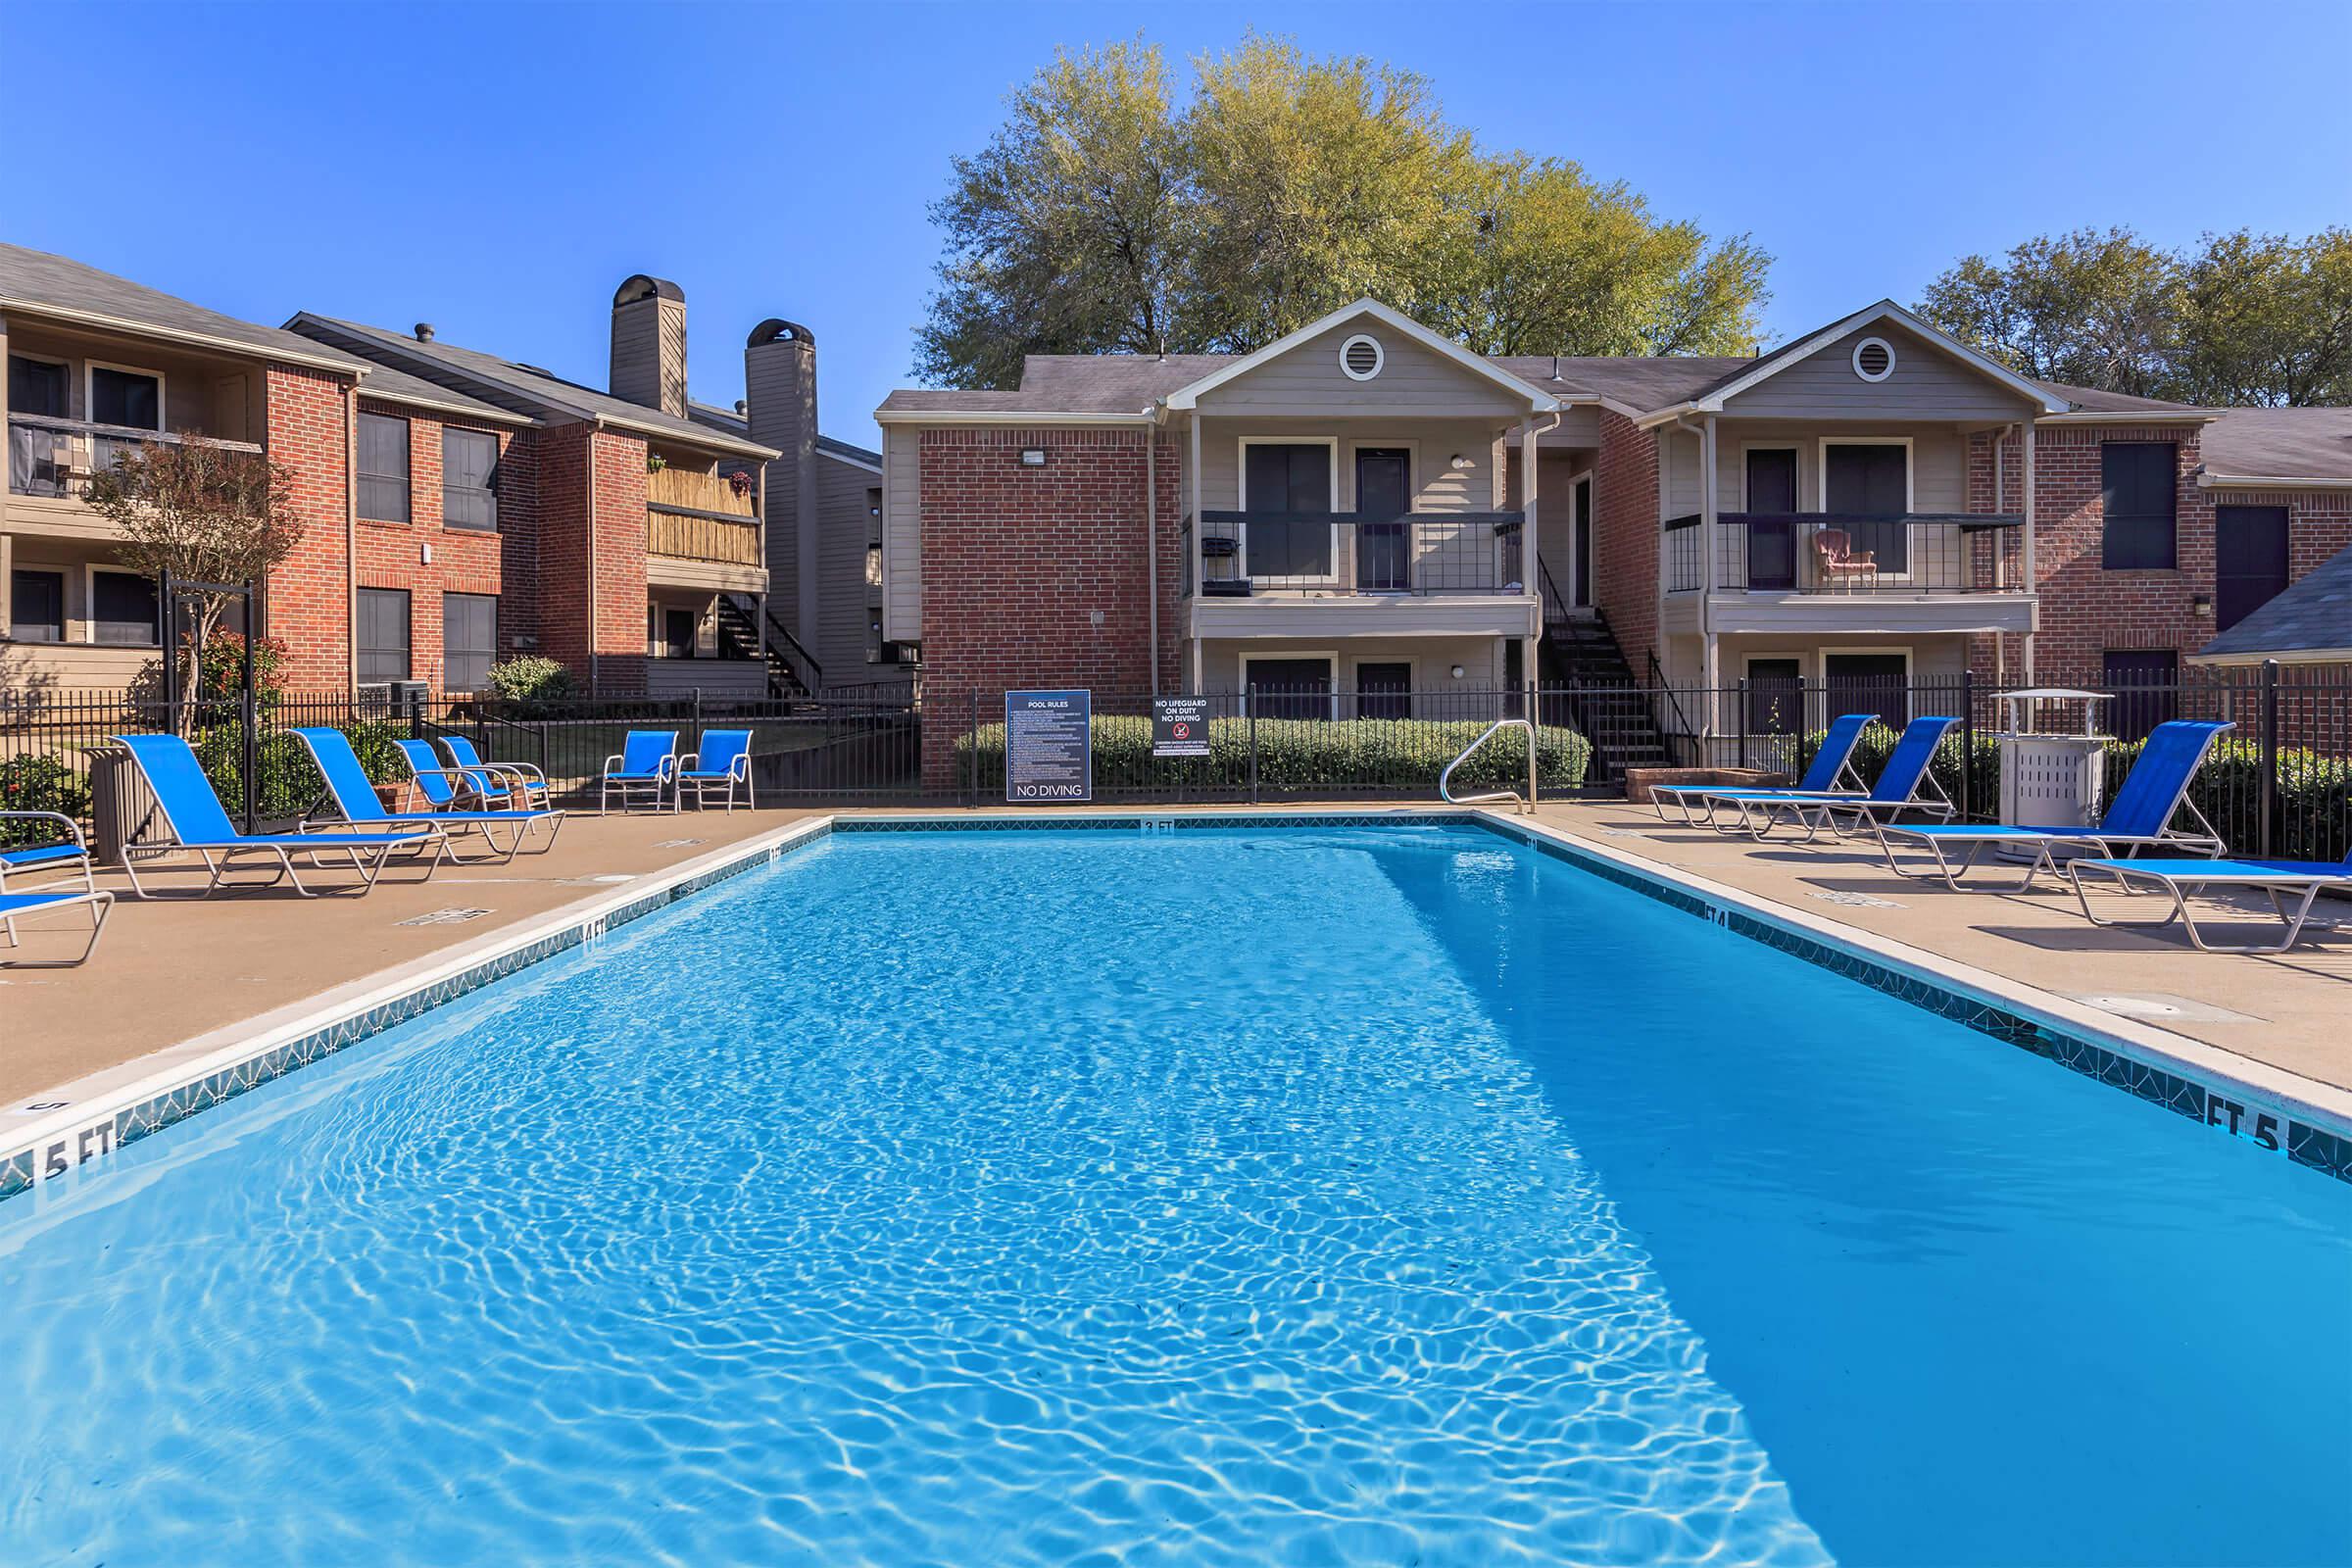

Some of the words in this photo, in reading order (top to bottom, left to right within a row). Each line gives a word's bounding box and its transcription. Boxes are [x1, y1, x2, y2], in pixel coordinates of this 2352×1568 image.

[1017, 785, 1036, 796] NO
[1040, 785, 1082, 796] DIVING
[1159, 821, 1172, 830] FT
[2207, 1094, 2244, 1137] FT
[2254, 1113, 2278, 1152] 5
[45, 1140, 69, 1181] 5
[78, 1119, 114, 1165] FT
